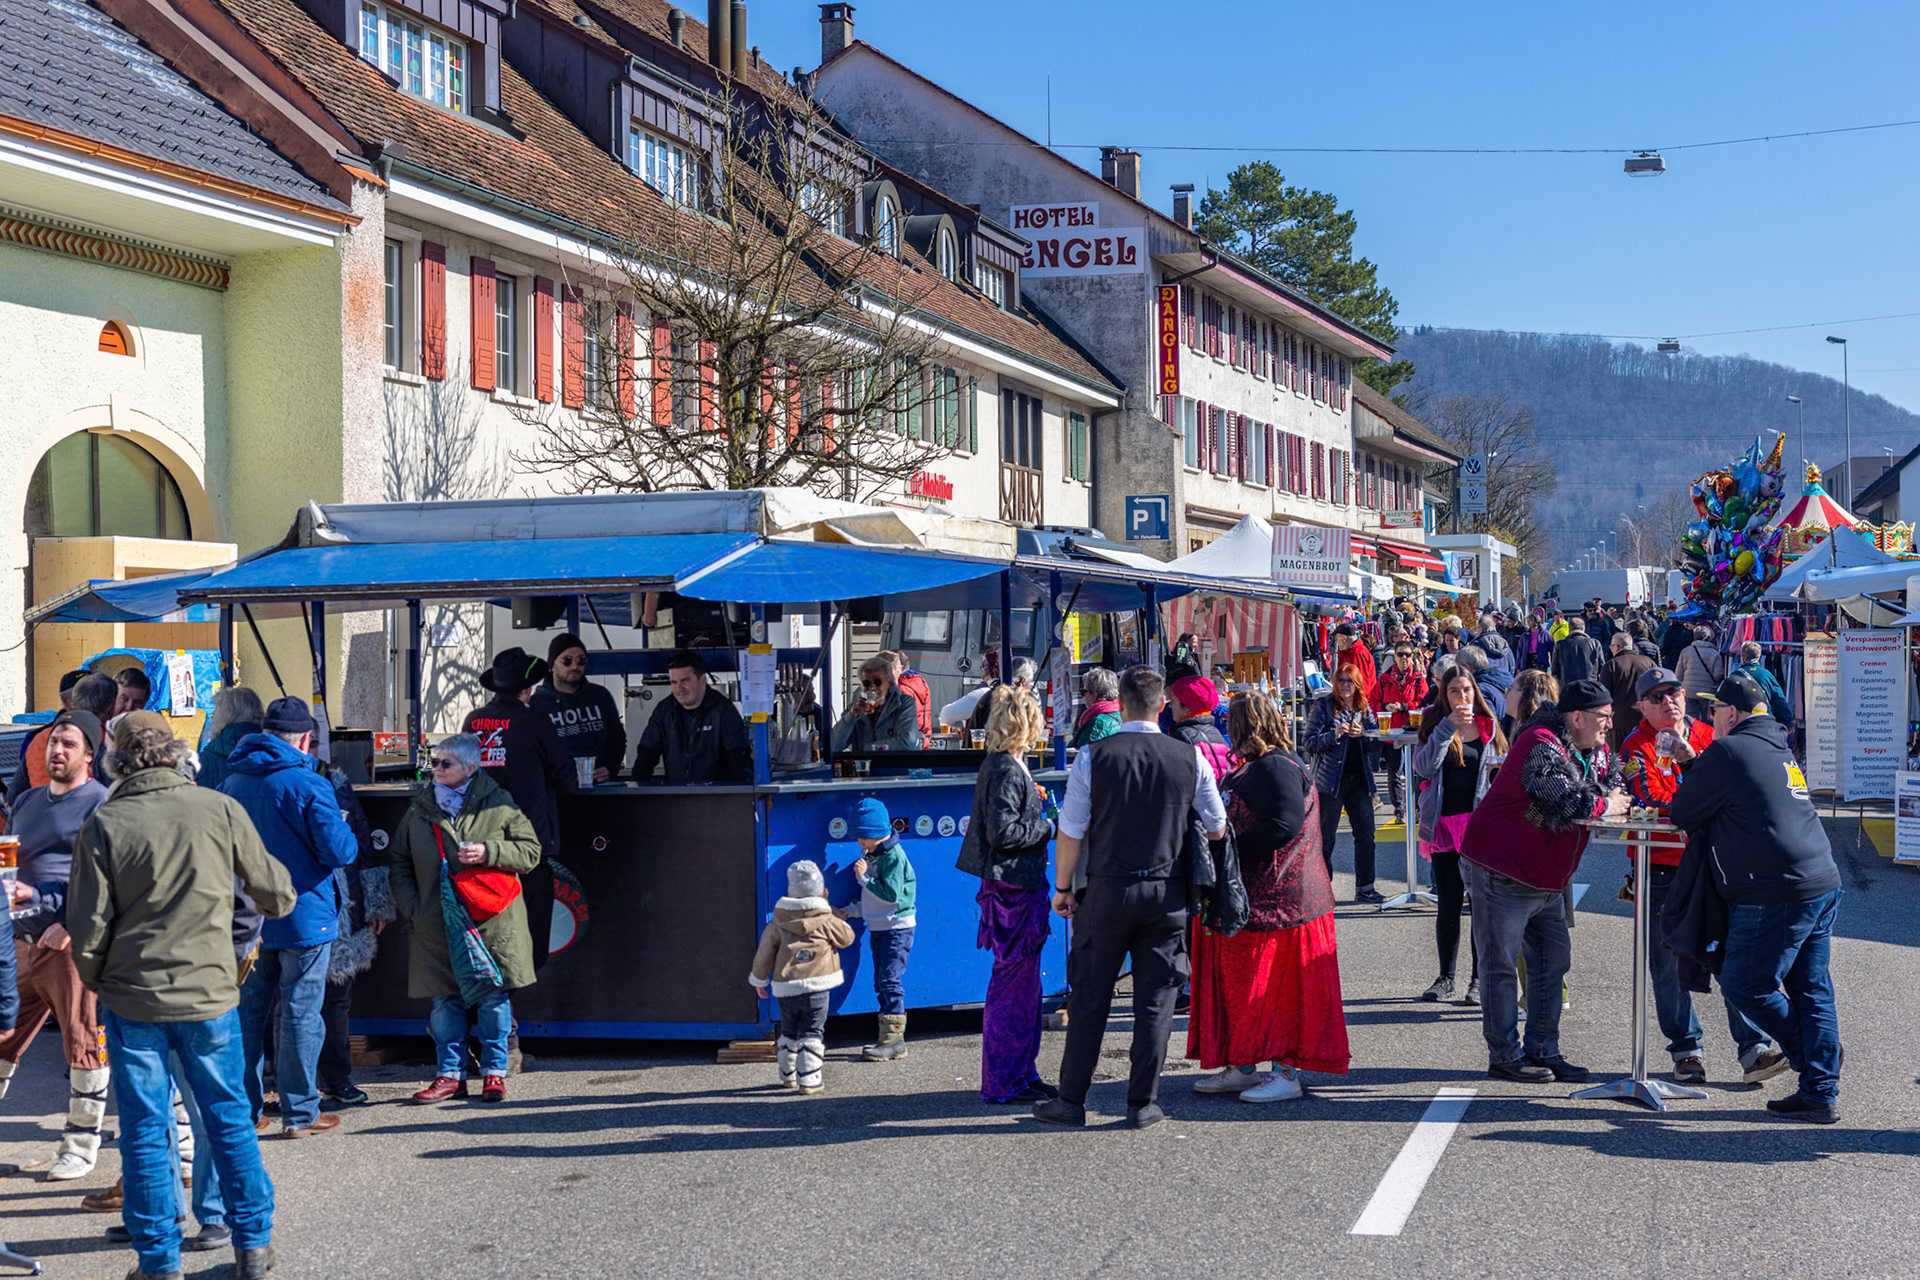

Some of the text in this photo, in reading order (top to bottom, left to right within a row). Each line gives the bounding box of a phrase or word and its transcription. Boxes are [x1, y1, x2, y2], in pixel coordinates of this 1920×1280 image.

[1014, 206, 1094, 229] HOTEL
[1020, 236, 1137, 269] ENGEL
[1161, 287, 1178, 394] DANCING
[1133, 509, 1149, 530] P
[1280, 559, 1341, 571] MAGENBROT
[549, 705, 602, 726] HOLLI
